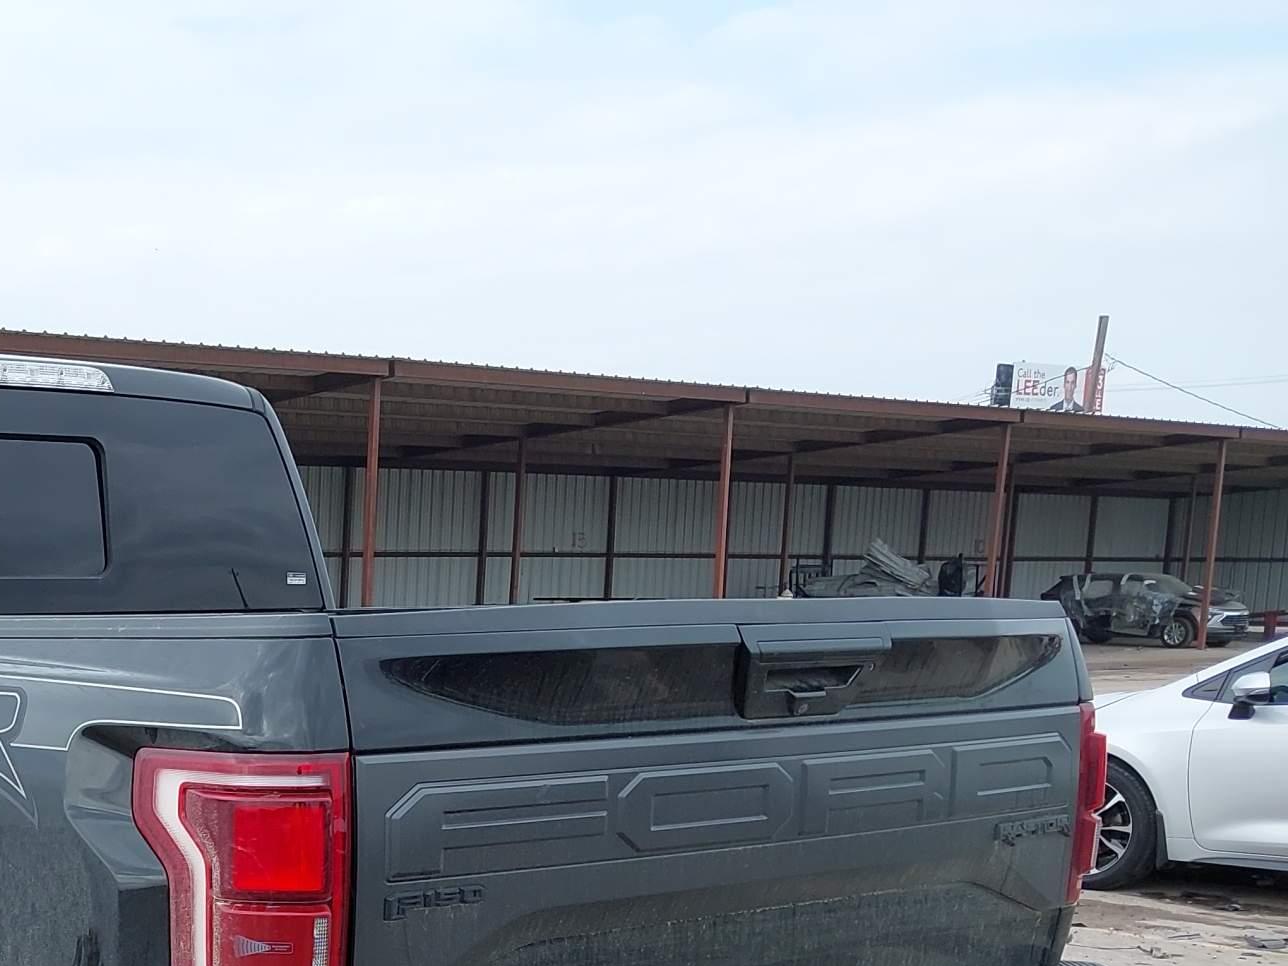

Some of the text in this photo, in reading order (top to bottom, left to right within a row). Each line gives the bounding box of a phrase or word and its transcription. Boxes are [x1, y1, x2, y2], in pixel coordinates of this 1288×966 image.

[1017, 368, 1032, 378] Call
[385, 733, 1072, 882] FORD
[993, 814, 1071, 847] RAPTOR
